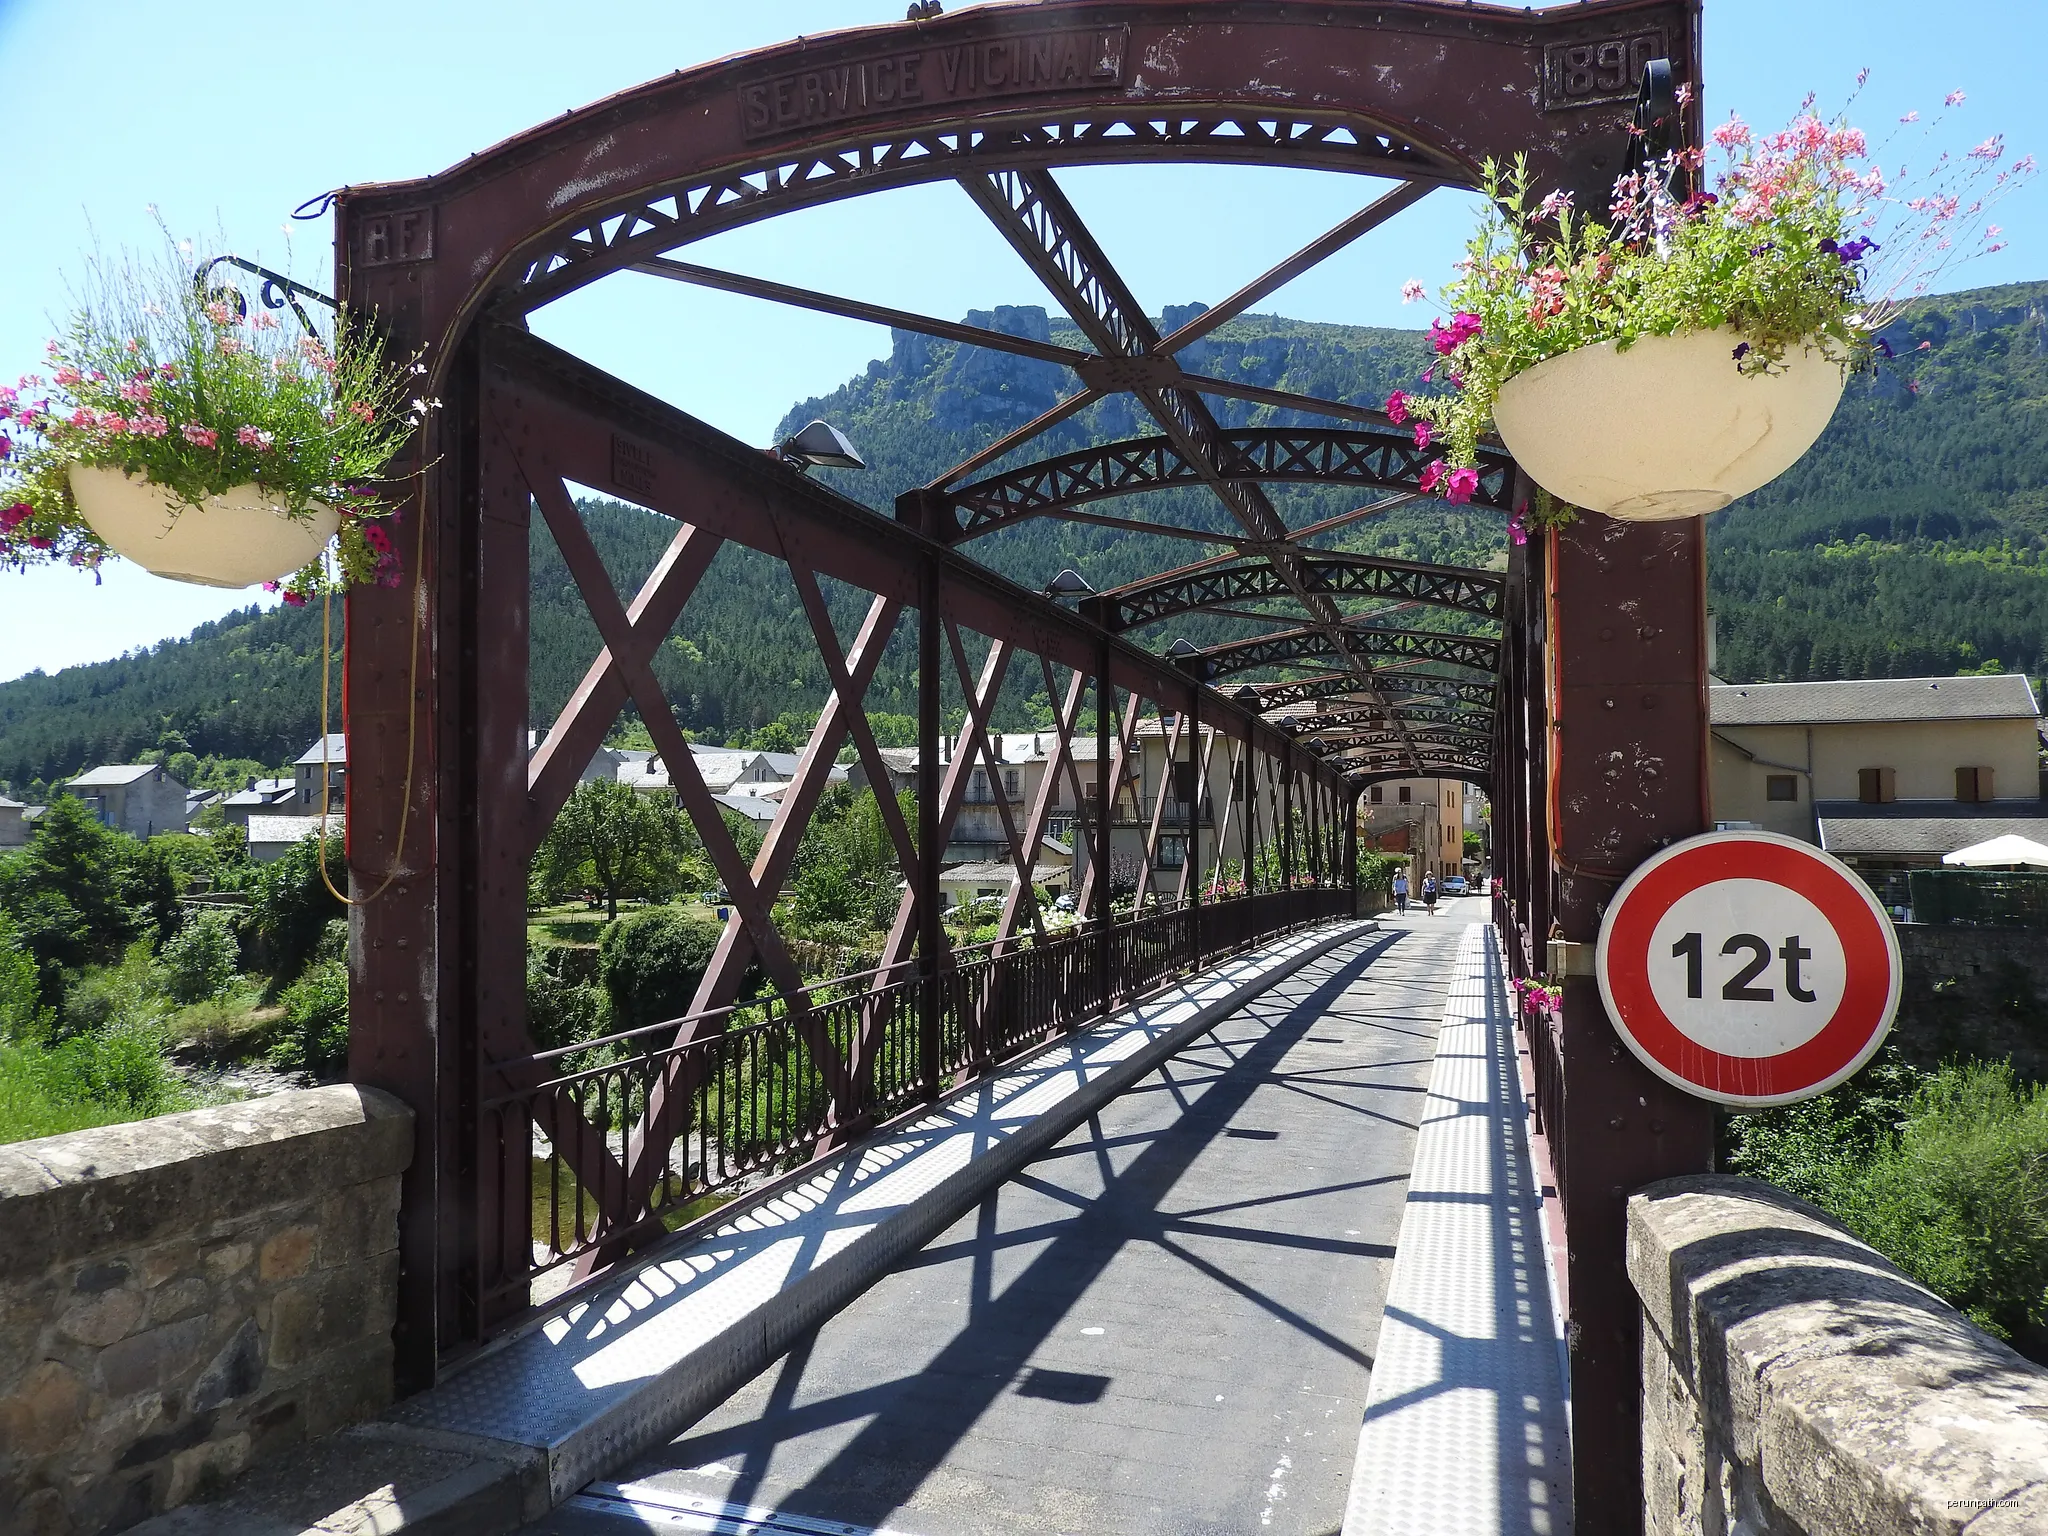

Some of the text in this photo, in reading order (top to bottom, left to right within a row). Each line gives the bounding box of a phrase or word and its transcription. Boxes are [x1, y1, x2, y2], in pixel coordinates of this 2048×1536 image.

[745, 33, 1114, 127] SERVICE VICINAL
[1672, 932, 1817, 1003] 12t
